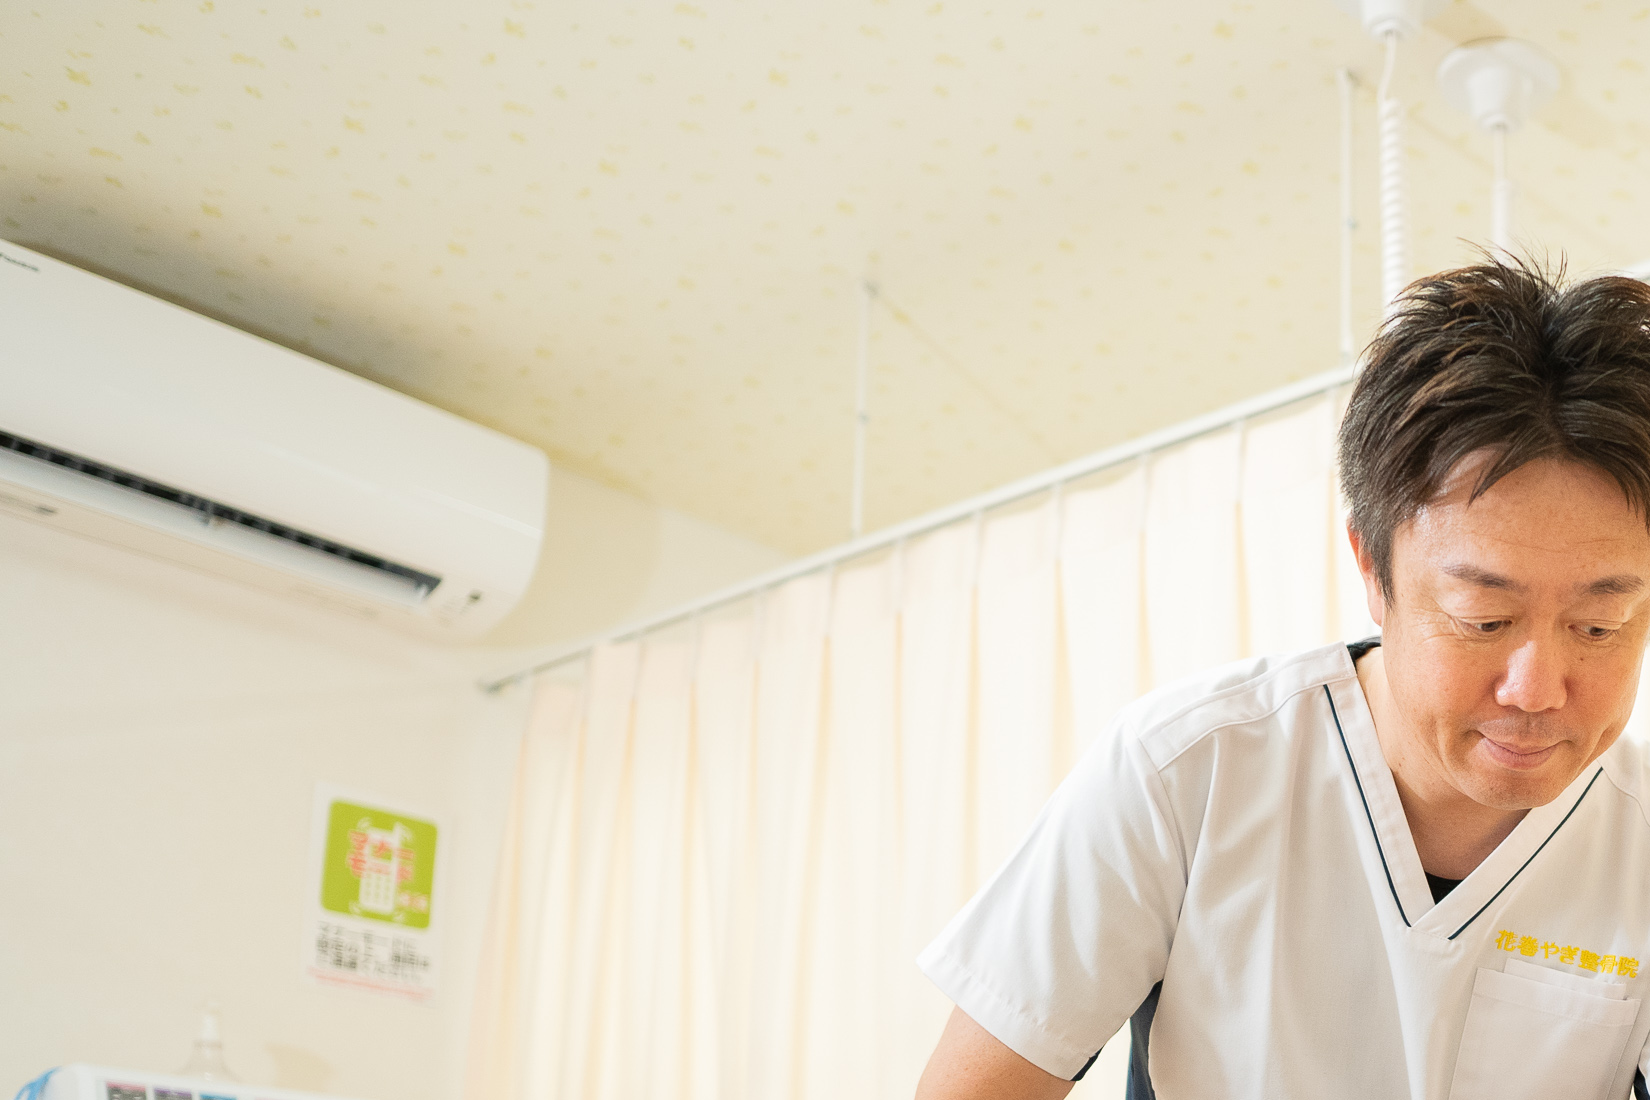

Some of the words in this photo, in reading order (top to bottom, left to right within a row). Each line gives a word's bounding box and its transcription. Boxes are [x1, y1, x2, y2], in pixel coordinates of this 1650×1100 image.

[1495, 929, 1640, 979] 花巻やぎ整骨院
